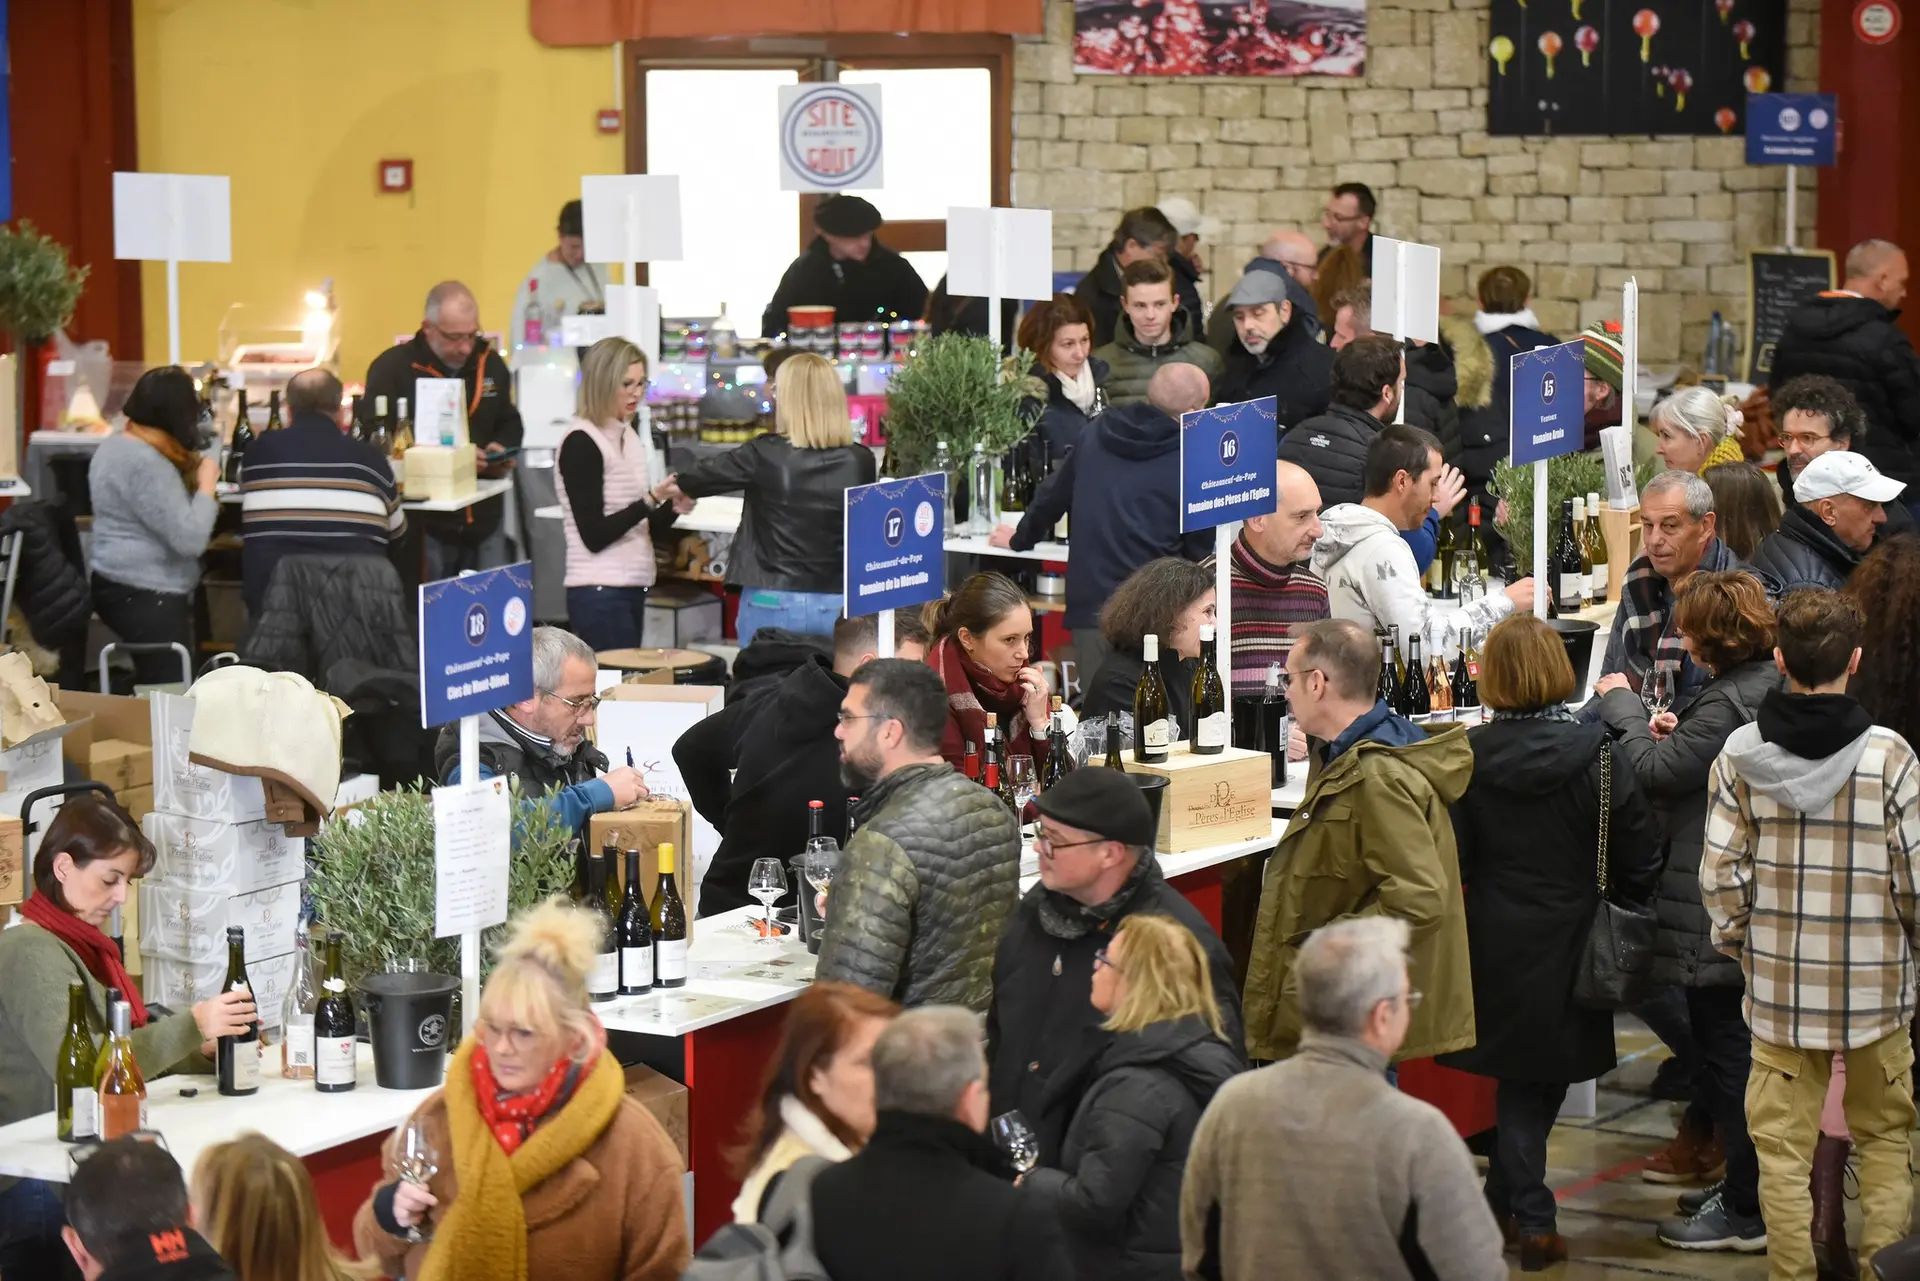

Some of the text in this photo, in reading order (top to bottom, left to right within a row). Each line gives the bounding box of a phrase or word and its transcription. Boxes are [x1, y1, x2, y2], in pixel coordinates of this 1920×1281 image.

[808, 101, 856, 127] SITE
[1544, 379, 1554, 397] 15
[1223, 439, 1236, 458] 16
[1201, 472, 1257, 490] Châteauneuf-du-Pape
[1188, 500, 1213, 514] Domaine
[1214, 496, 1225, 509] des
[1225, 493, 1242, 507] Pères
[1242, 490, 1250, 503] de
[888, 517, 900, 538] 17
[860, 580, 885, 596] Domaine
[470, 613, 485, 637] 18
[1195, 812, 1219, 825] Pères
